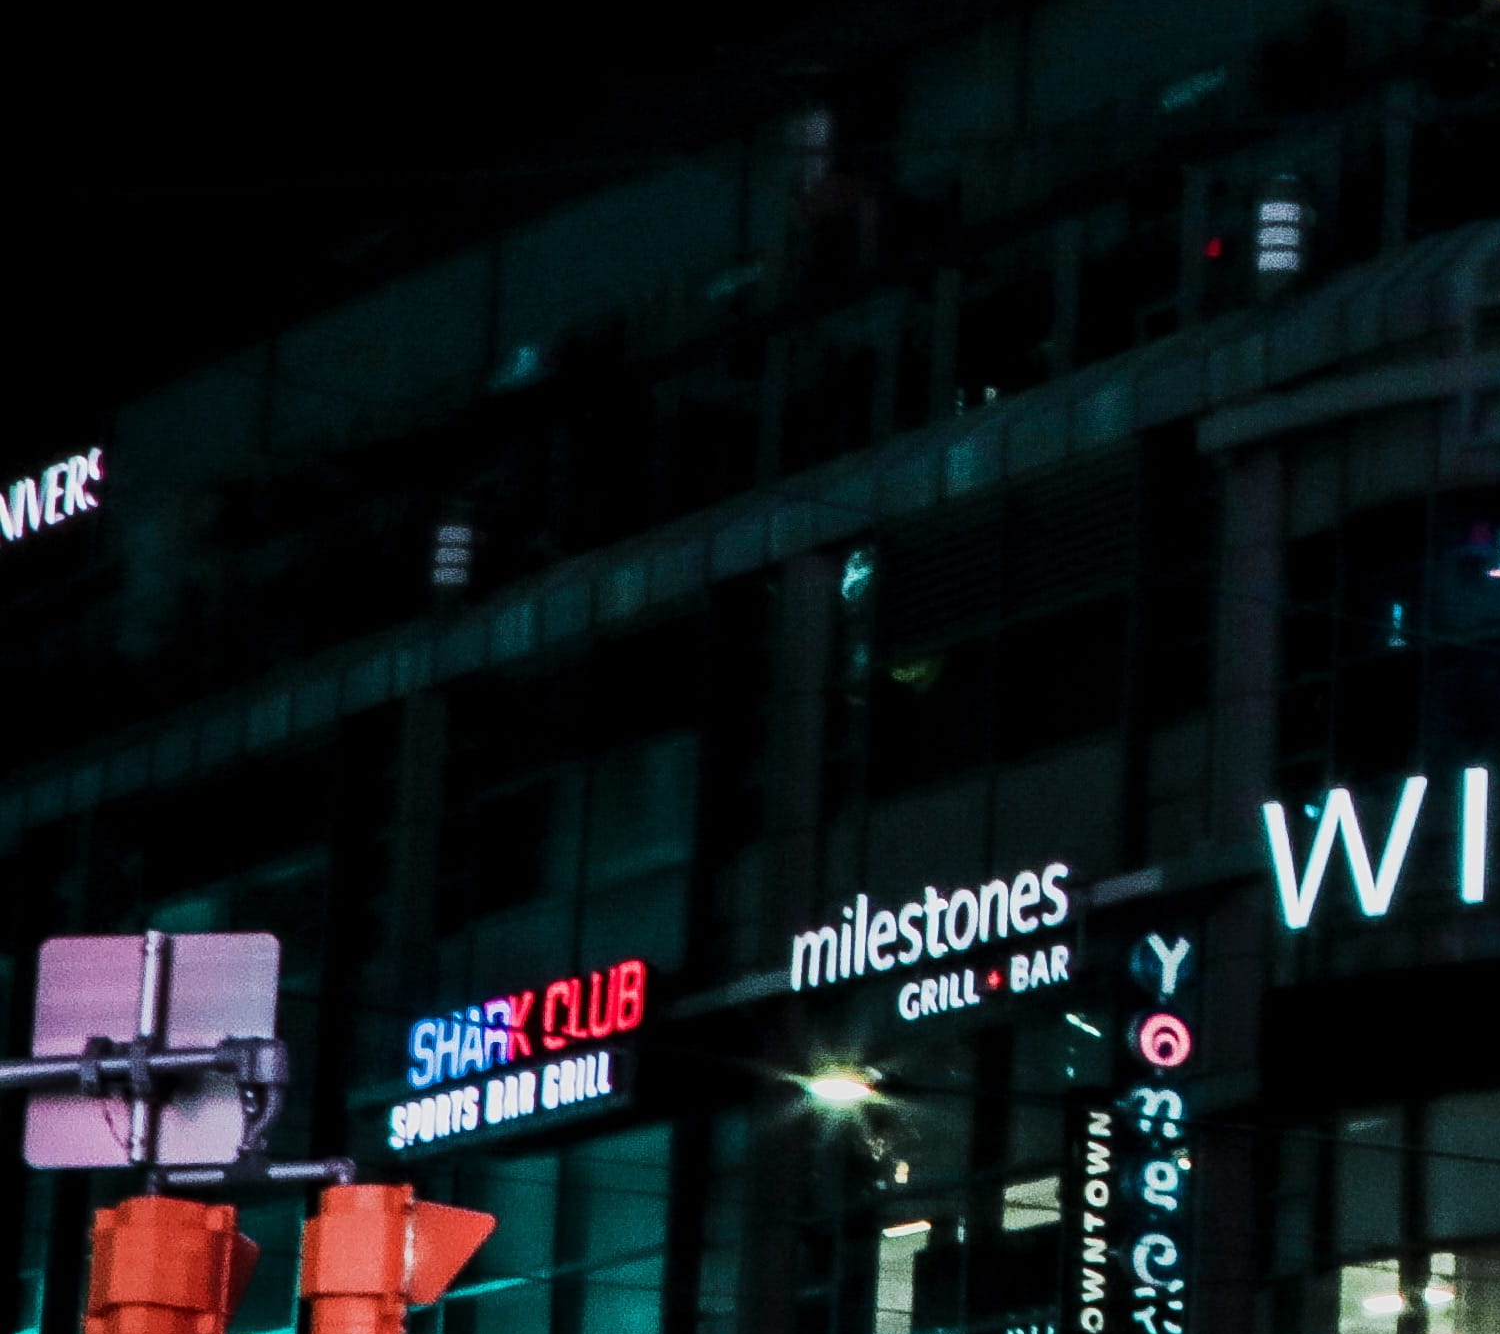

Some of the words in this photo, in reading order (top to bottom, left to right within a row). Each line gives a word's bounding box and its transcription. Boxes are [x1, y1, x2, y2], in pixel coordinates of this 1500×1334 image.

[790, 861, 1069, 992] milestones
[543, 960, 648, 1051] CLUB
[898, 968, 981, 1021] GRILL
[1009, 945, 1069, 993] BAR
[388, 1085, 479, 1150] SPORTS
[484, 1070, 536, 1125] BAR
[541, 1051, 612, 1109] GRILL
